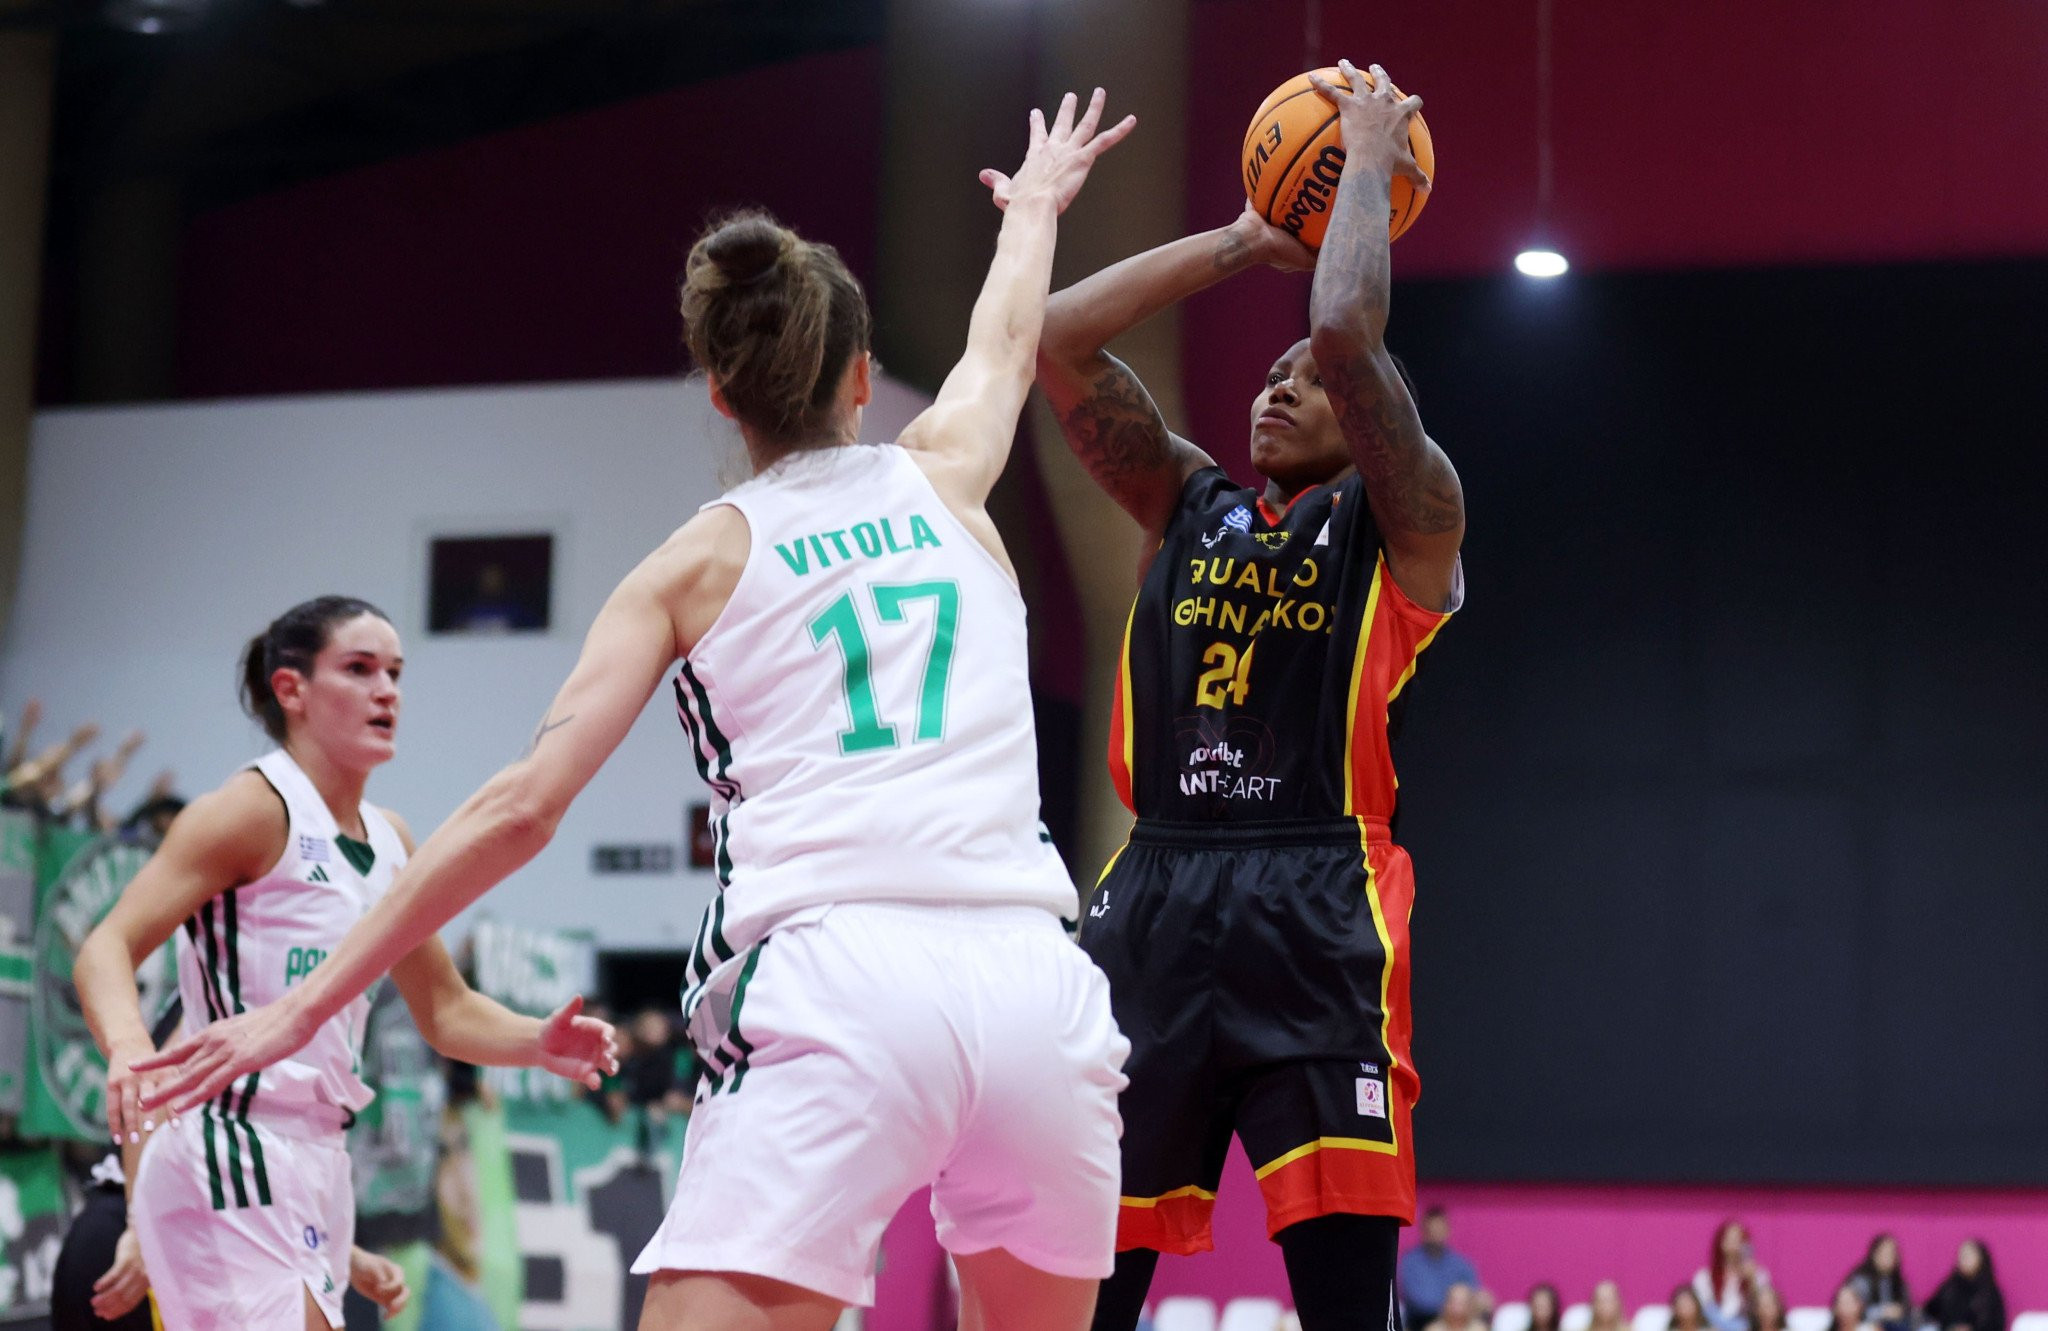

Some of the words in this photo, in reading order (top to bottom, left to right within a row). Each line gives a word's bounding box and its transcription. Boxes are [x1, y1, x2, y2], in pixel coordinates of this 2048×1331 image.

[774, 514, 942, 577] VITOLA
[806, 577, 962, 757] 17
[1196, 641, 1255, 710] 24
